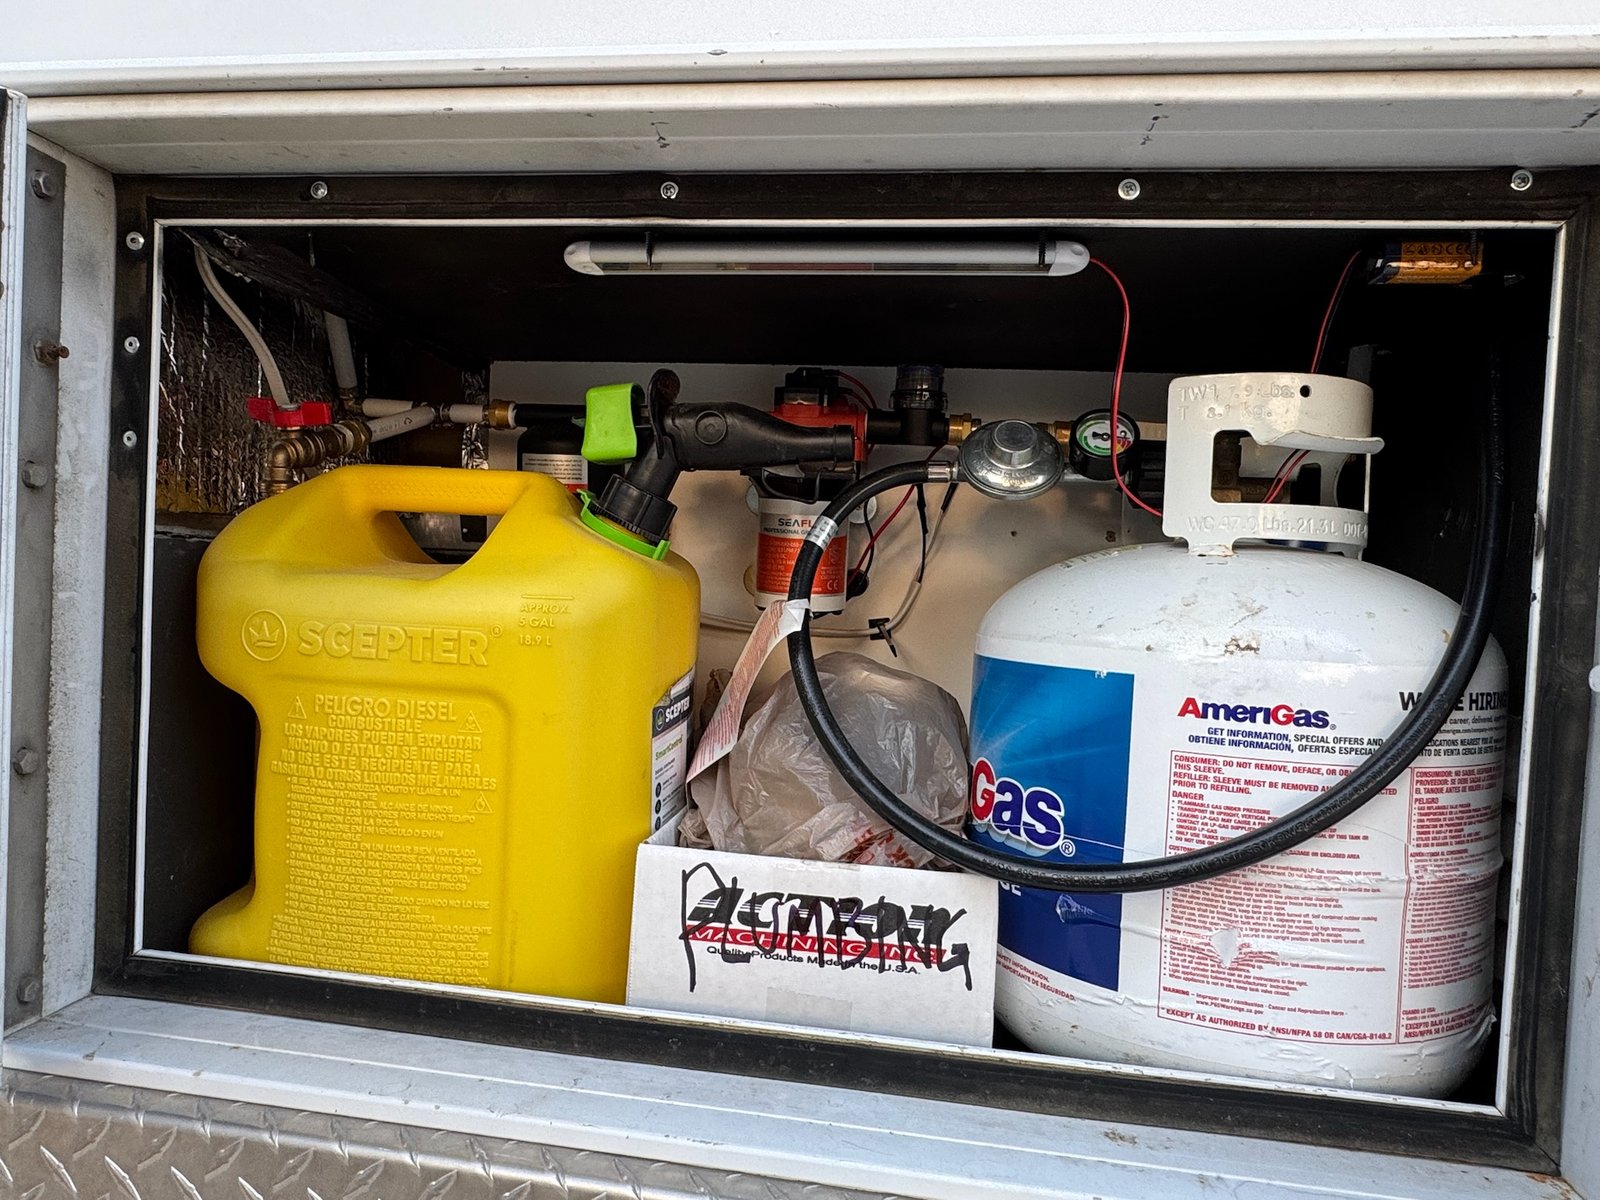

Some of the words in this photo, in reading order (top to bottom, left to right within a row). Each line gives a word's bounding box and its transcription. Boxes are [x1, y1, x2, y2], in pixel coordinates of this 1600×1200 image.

[777, 517, 812, 528] SEAFL
[518, 616, 526, 626] 5
[529, 616, 555, 628] GAL
[298, 620, 488, 667] SCEPTER
[519, 634, 542, 646] 18.9
[546, 635, 552, 646] L
[315, 694, 390, 717] PELIGRO
[396, 700, 457, 721] DIESEL
[665, 696, 690, 723] SCEPTER
[1177, 697, 1330, 729] AmeriGas
[328, 715, 422, 733] COMBUSTIBLE
[284, 722, 303, 737] LOS
[305, 724, 359, 743] VAPORES
[362, 730, 413, 746] PUEDEN
[417, 735, 482, 750] EXPLOTAR
[1188, 734, 1226, 747] OBTIENE
[1228, 738, 1294, 753] INFORMACIÓN,
[1297, 744, 1337, 755] OFERTAS
[1338, 746, 1379, 757] ESPECIA
[1207, 726, 1225, 737] GET
[1226, 728, 1291, 743] INFORMATION,
[1294, 734, 1330, 745] SPECIAL
[1333, 736, 1365, 746] OFFERS
[1366, 738, 1384, 747] AND
[288, 736, 328, 754] NOCIVO
[332, 741, 340, 754] O
[344, 742, 382, 758] FATAL
[385, 745, 398, 759] SI
[401, 746, 417, 760] SE
[421, 748, 473, 763] INGIERE
[1433, 748, 1442, 757] DE
[1443, 748, 1461, 757] VENTA
[280, 749, 296, 762] NO
[298, 750, 320, 766] USE
[324, 754, 357, 769] ESTE
[361, 757, 439, 775] RECIPIENTE
[444, 763, 481, 777] PARA
[1173, 754, 1220, 767] CONSUMER:
[1222, 758, 1234, 768] DO
[1236, 759, 1252, 770] NOT
[1254, 761, 1290, 774] REMOVE,
[1292, 765, 1323, 776] DEFACE,
[1325, 767, 1337, 776] OR
[1173, 762, 1192, 773] THIS
[1193, 764, 1225, 775] SLEEVE.
[271, 760, 315, 779] GASOLINA
[326, 766, 362, 782] OTROS
[363, 771, 416, 787] LIQUIDOS
[417, 774, 497, 791] INFLAMABLES
[1173, 771, 1211, 783] REFILLER:
[1212, 775, 1242, 786] SLEEVE
[1243, 778, 1267, 788] MUST
[1268, 781, 1279, 789] BE
[1281, 782, 1319, 792] REMOVED
[1171, 791, 1204, 801] DANGER
[1173, 779, 1197, 790] PRIOR
[1198, 781, 1208, 790] TO
[1209, 783, 1252, 795] REFILLING.
[1414, 787, 1422, 795] EL
[1423, 786, 1444, 795] TANQUE
[1177, 800, 1210, 809] FLAMMABLE
[1223, 805, 1241, 813] UNDER
[1242, 807, 1270, 815] PRESSURE
[1414, 797, 1439, 805] PELIGRO
[1176, 818, 1199, 826] CONTACT
[1209, 822, 1229, 830] LP-GAS
[1177, 806, 1208, 814] TRANSPORT
[1241, 813, 1266, 821] VERTICAL
[1177, 812, 1199, 820] LEAKING
[1233, 818, 1251, 826] CAUSE
[1176, 824, 1197, 832] UNUSED
[679, 862, 973, 992] PLUMBING
[752, 950, 804, 964] Products
[860, 961, 878, 972] the
[1001, 961, 1031, 983] IMPORTANTE
[1031, 977, 1040, 987] DE
[1039, 981, 1077, 1002] SEGURIDAD.
[1162, 986, 1190, 997] WARNING
[1196, 992, 1219, 1002] Improper
[1297, 1007, 1330, 1016] Reproductive
[1166, 1008, 1194, 1020] EXCEPT
[1196, 1014, 1207, 1022] AS
[1208, 1016, 1256, 1031] AUTHORIZED
[1257, 1023, 1268, 1032] BY
[1312, 1030, 1323, 1038] 58
[1324, 1031, 1335, 1039] OR
